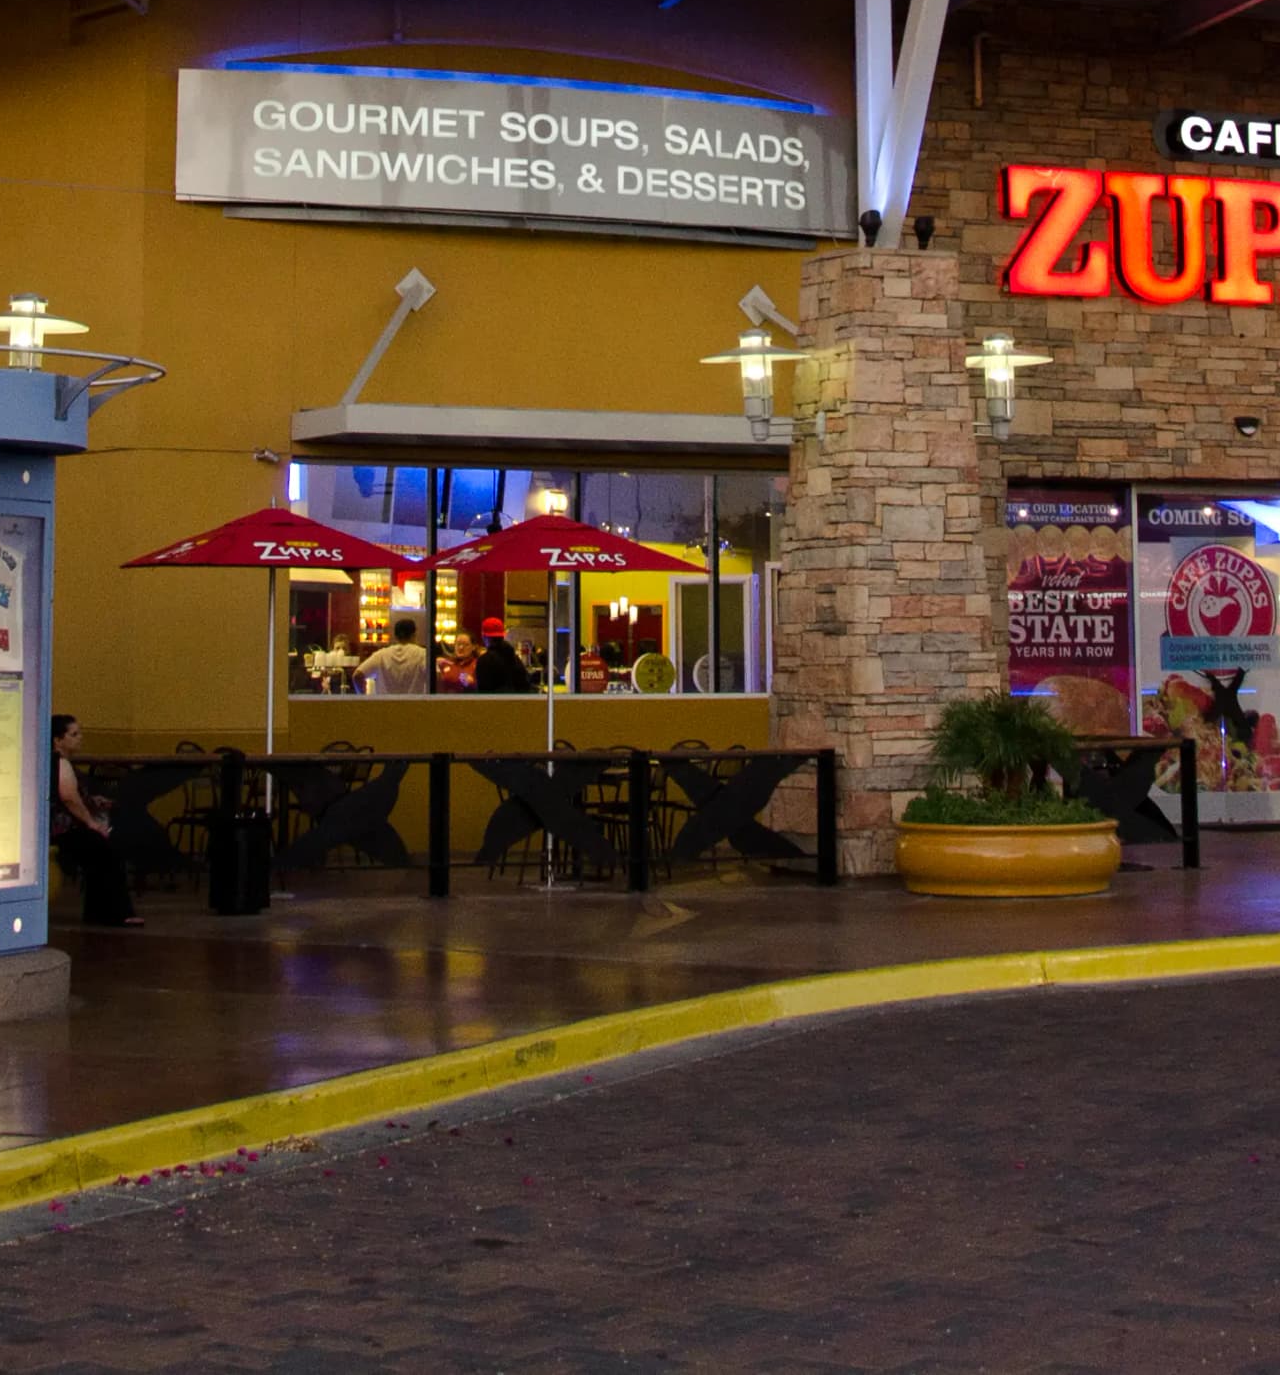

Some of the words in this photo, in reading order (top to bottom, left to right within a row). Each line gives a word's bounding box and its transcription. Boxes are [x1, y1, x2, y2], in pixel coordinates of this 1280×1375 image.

[252, 99, 485, 140] GOURMET
[499, 112, 650, 158] SOUPS,
[663, 124, 811, 173] SALADS,
[252, 147, 565, 196] SANDWICHES,
[576, 162, 606, 194] &
[616, 165, 807, 211] DESSERTS
[1032, 504, 1057, 514] OUR
[1148, 508, 1223, 525] COMING
[1227, 509, 1254, 525] SO
[252, 541, 344, 561] Zupas
[539, 547, 626, 567] Zupas
[1172, 549, 1211, 611] CAFÉ
[1214, 552, 1269, 610] ZUPAS
[1008, 590, 1079, 613] BEST
[1087, 592, 1113, 610] OF
[1009, 614, 1115, 644] STATE
[1015, 646, 1055, 658] YEARS
[1059, 646, 1071, 658] IN
[1075, 646, 1083, 658] A
[1086, 646, 1114, 658] ROW
